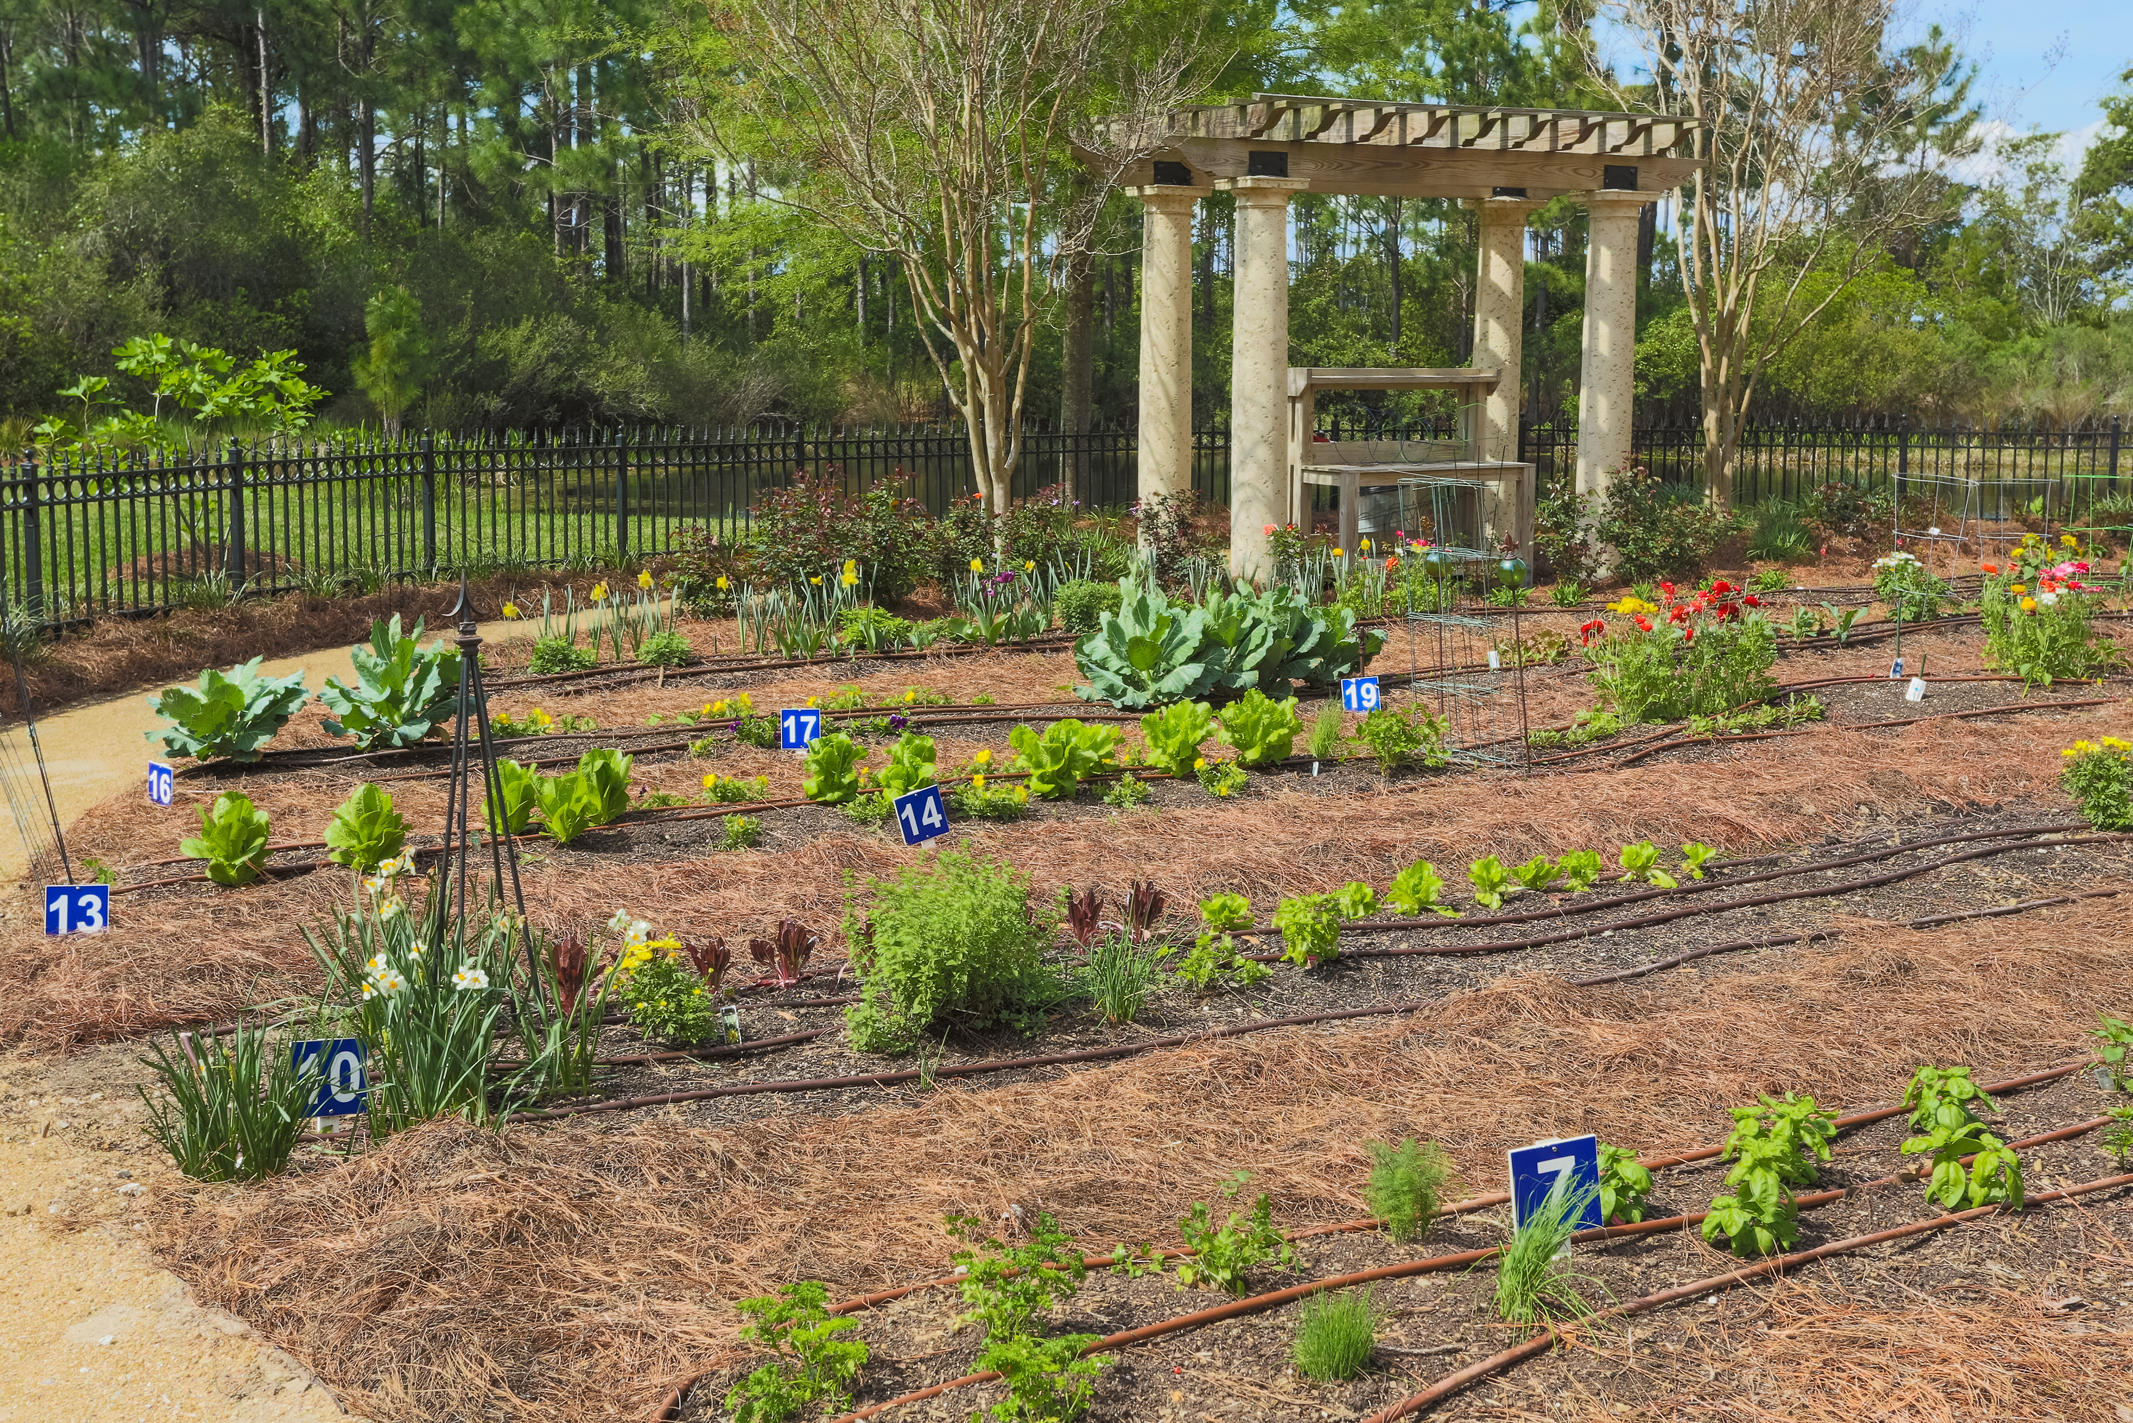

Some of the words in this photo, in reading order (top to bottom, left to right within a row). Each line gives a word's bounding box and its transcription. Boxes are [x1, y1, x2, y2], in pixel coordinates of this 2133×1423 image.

[1345, 682, 1377, 709] 19
[783, 715, 817, 744] 17
[149, 770, 171, 804] 16
[901, 795, 943, 836] 14
[49, 894, 104, 935] 13
[1537, 1155, 1576, 1218] 7
